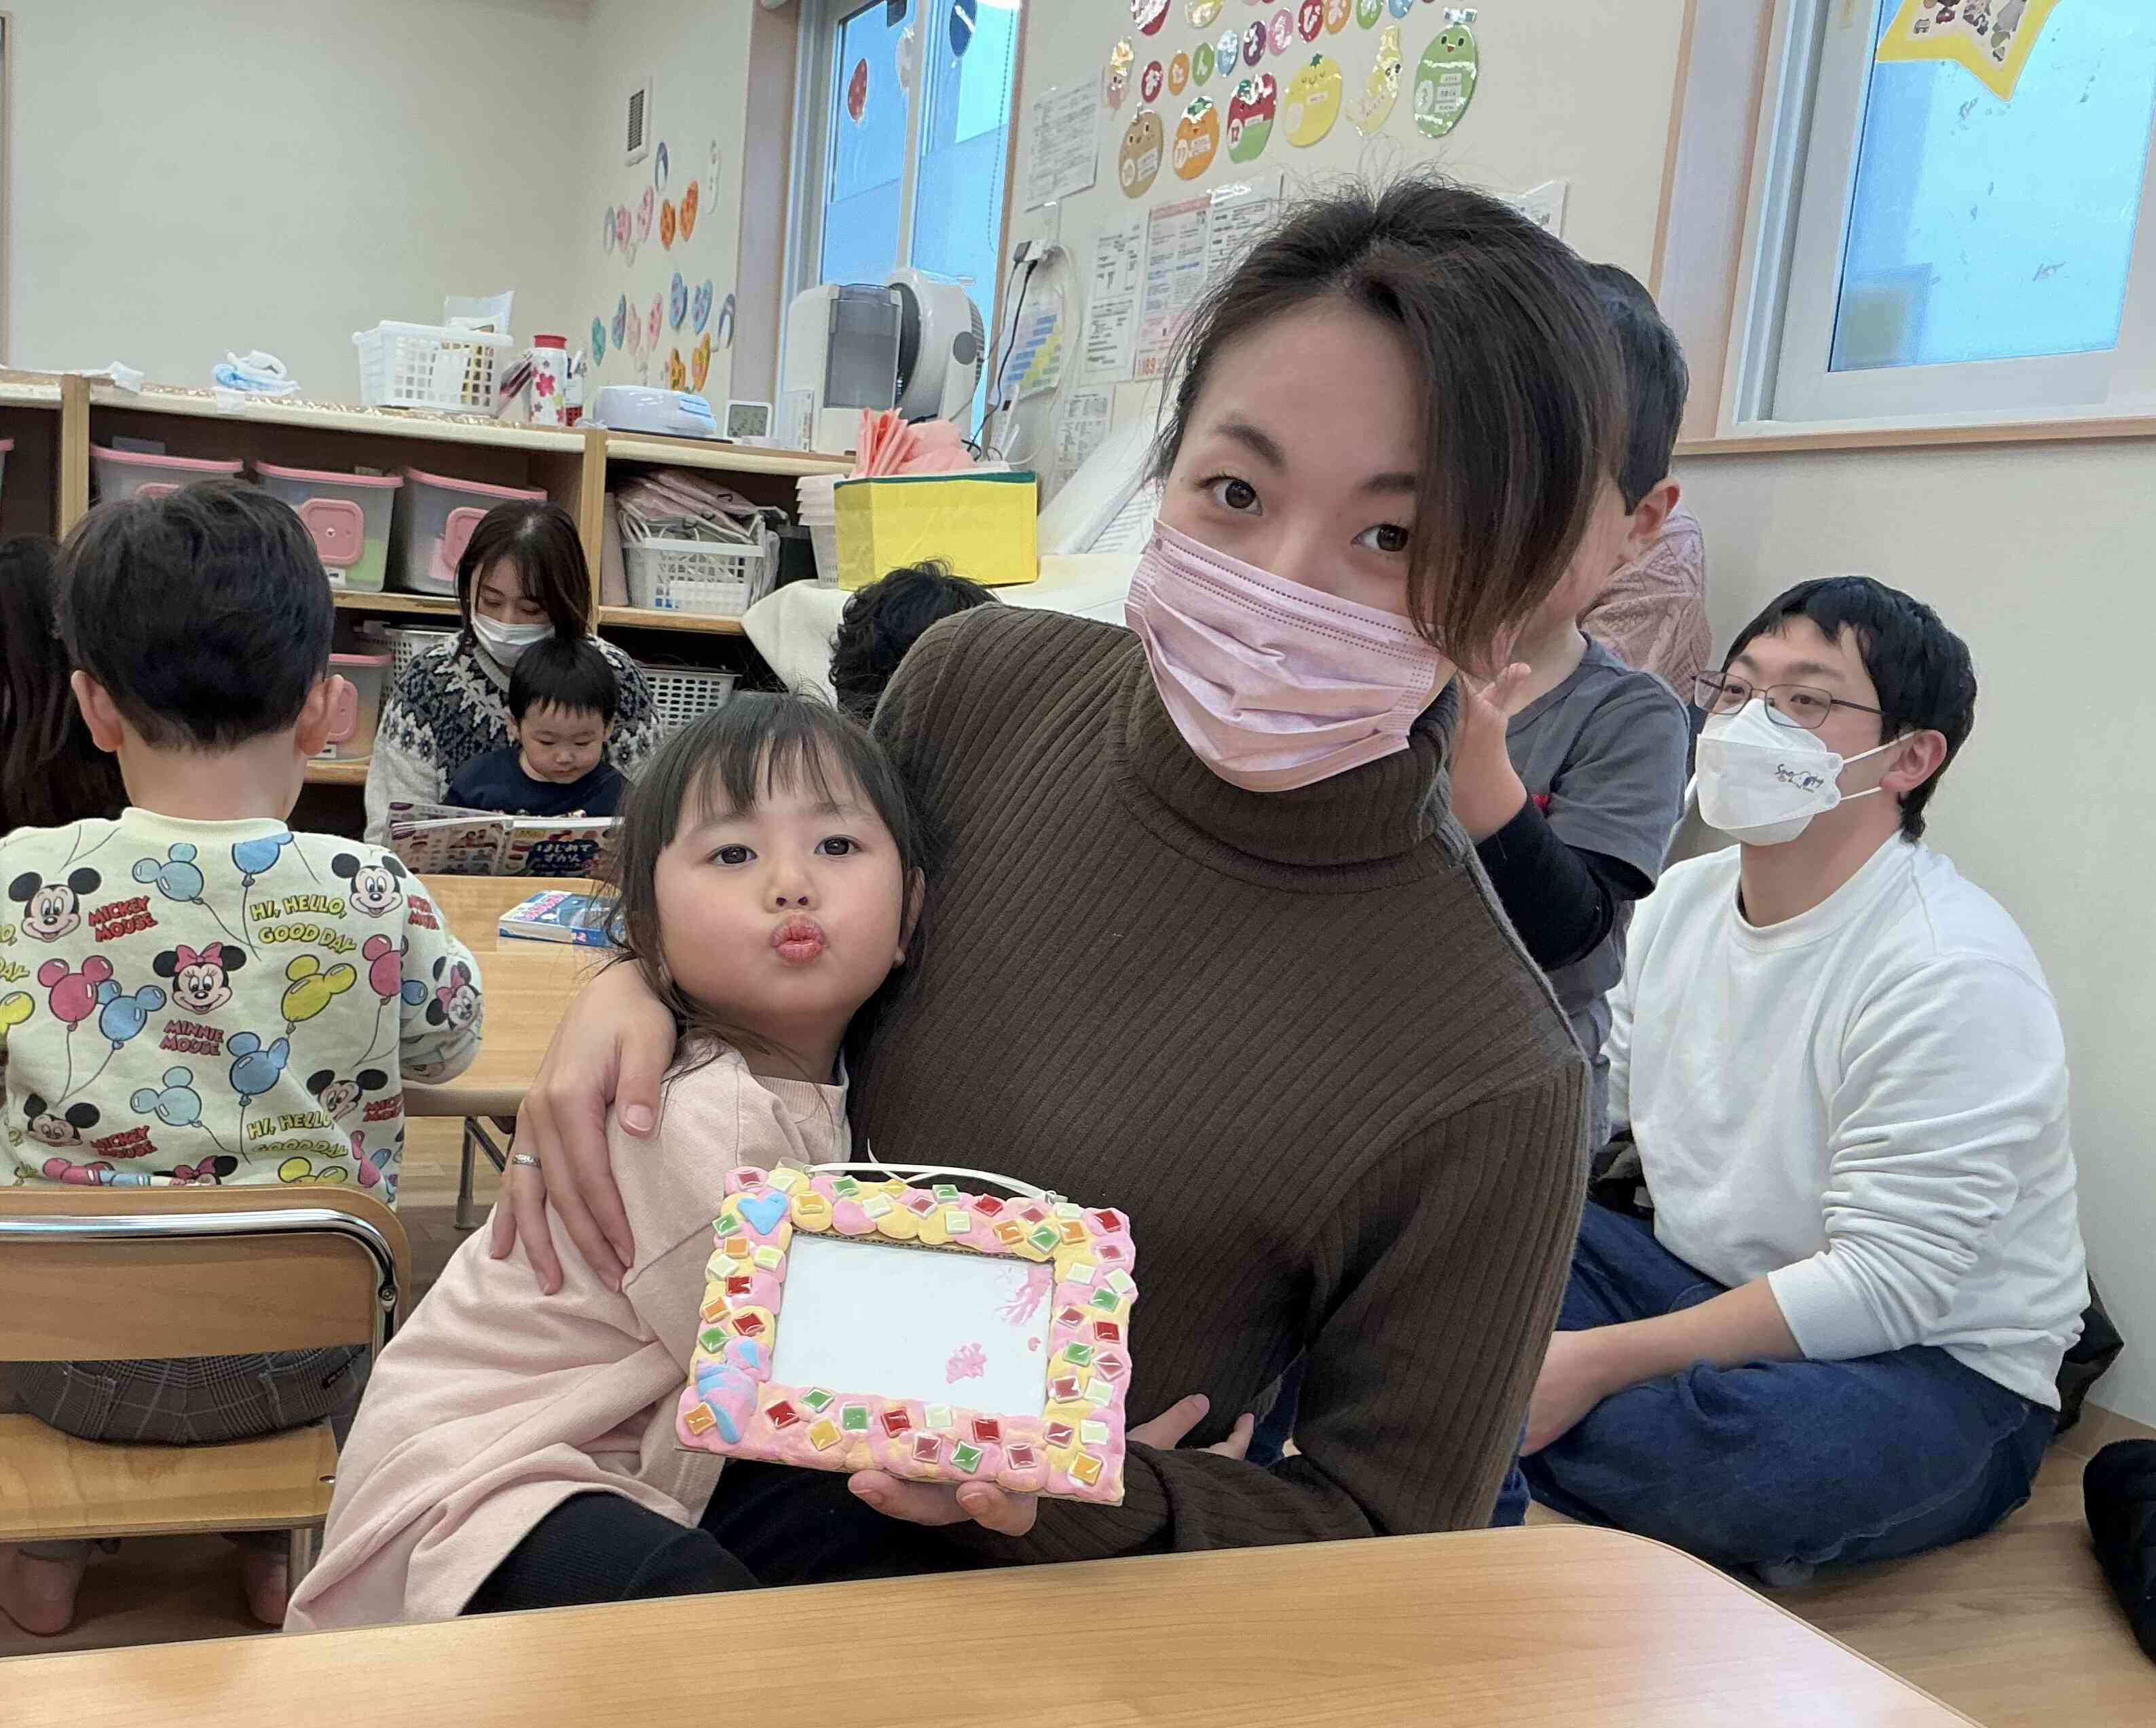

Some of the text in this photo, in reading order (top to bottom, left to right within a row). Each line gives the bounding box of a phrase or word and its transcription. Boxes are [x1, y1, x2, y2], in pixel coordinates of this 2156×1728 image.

[89, 895, 150, 927] MICKEY
[250, 894, 347, 921] HI, HELLO,
[95, 912, 157, 942] MOUSE
[259, 923, 357, 954] GOOD DAY
[163, 1019, 224, 1044] MINNIE
[159, 1035, 221, 1056] MOUSE
[246, 1118, 276, 1140] HI,
